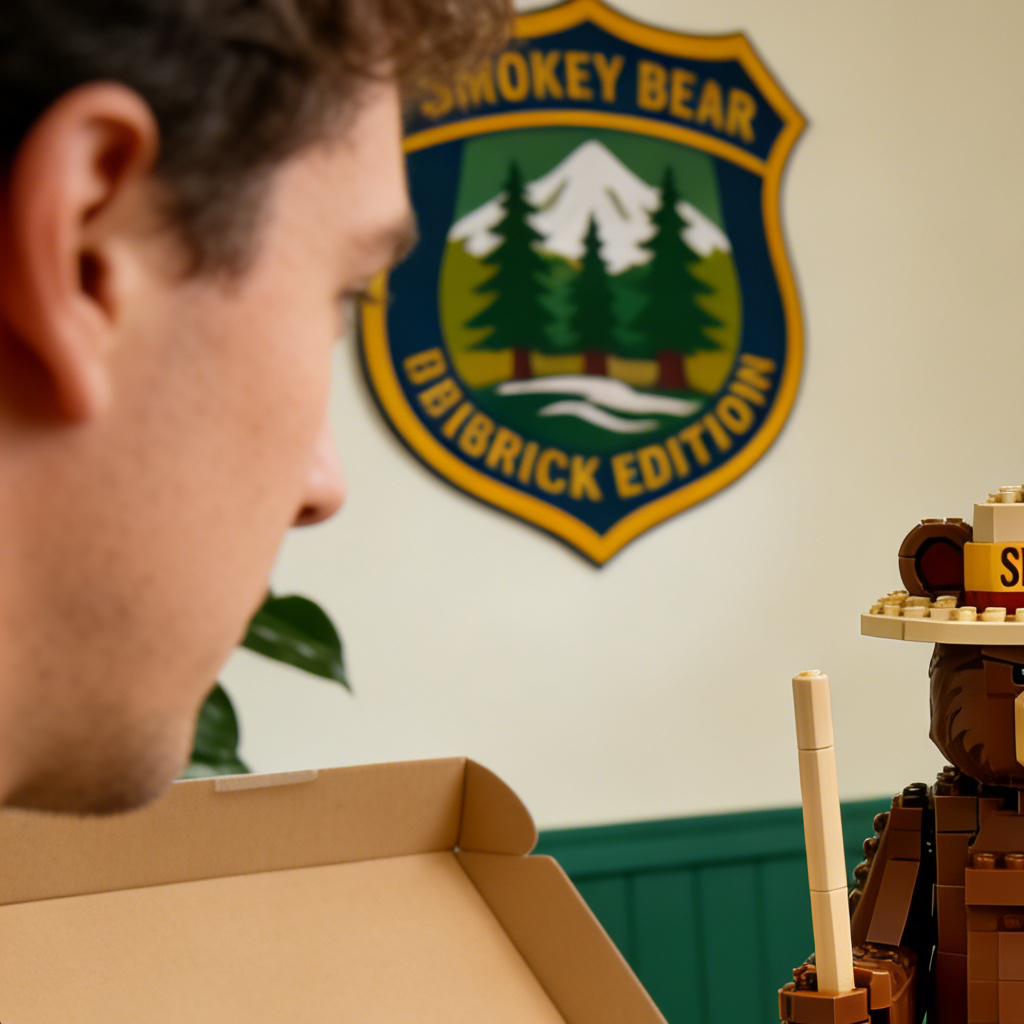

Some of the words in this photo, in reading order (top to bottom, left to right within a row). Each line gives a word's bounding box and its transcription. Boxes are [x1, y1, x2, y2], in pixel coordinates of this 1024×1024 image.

[419, 50, 624, 118] SMOKEY
[637, 60, 757, 143] BEAR
[611, 353, 776, 500] EDITION
